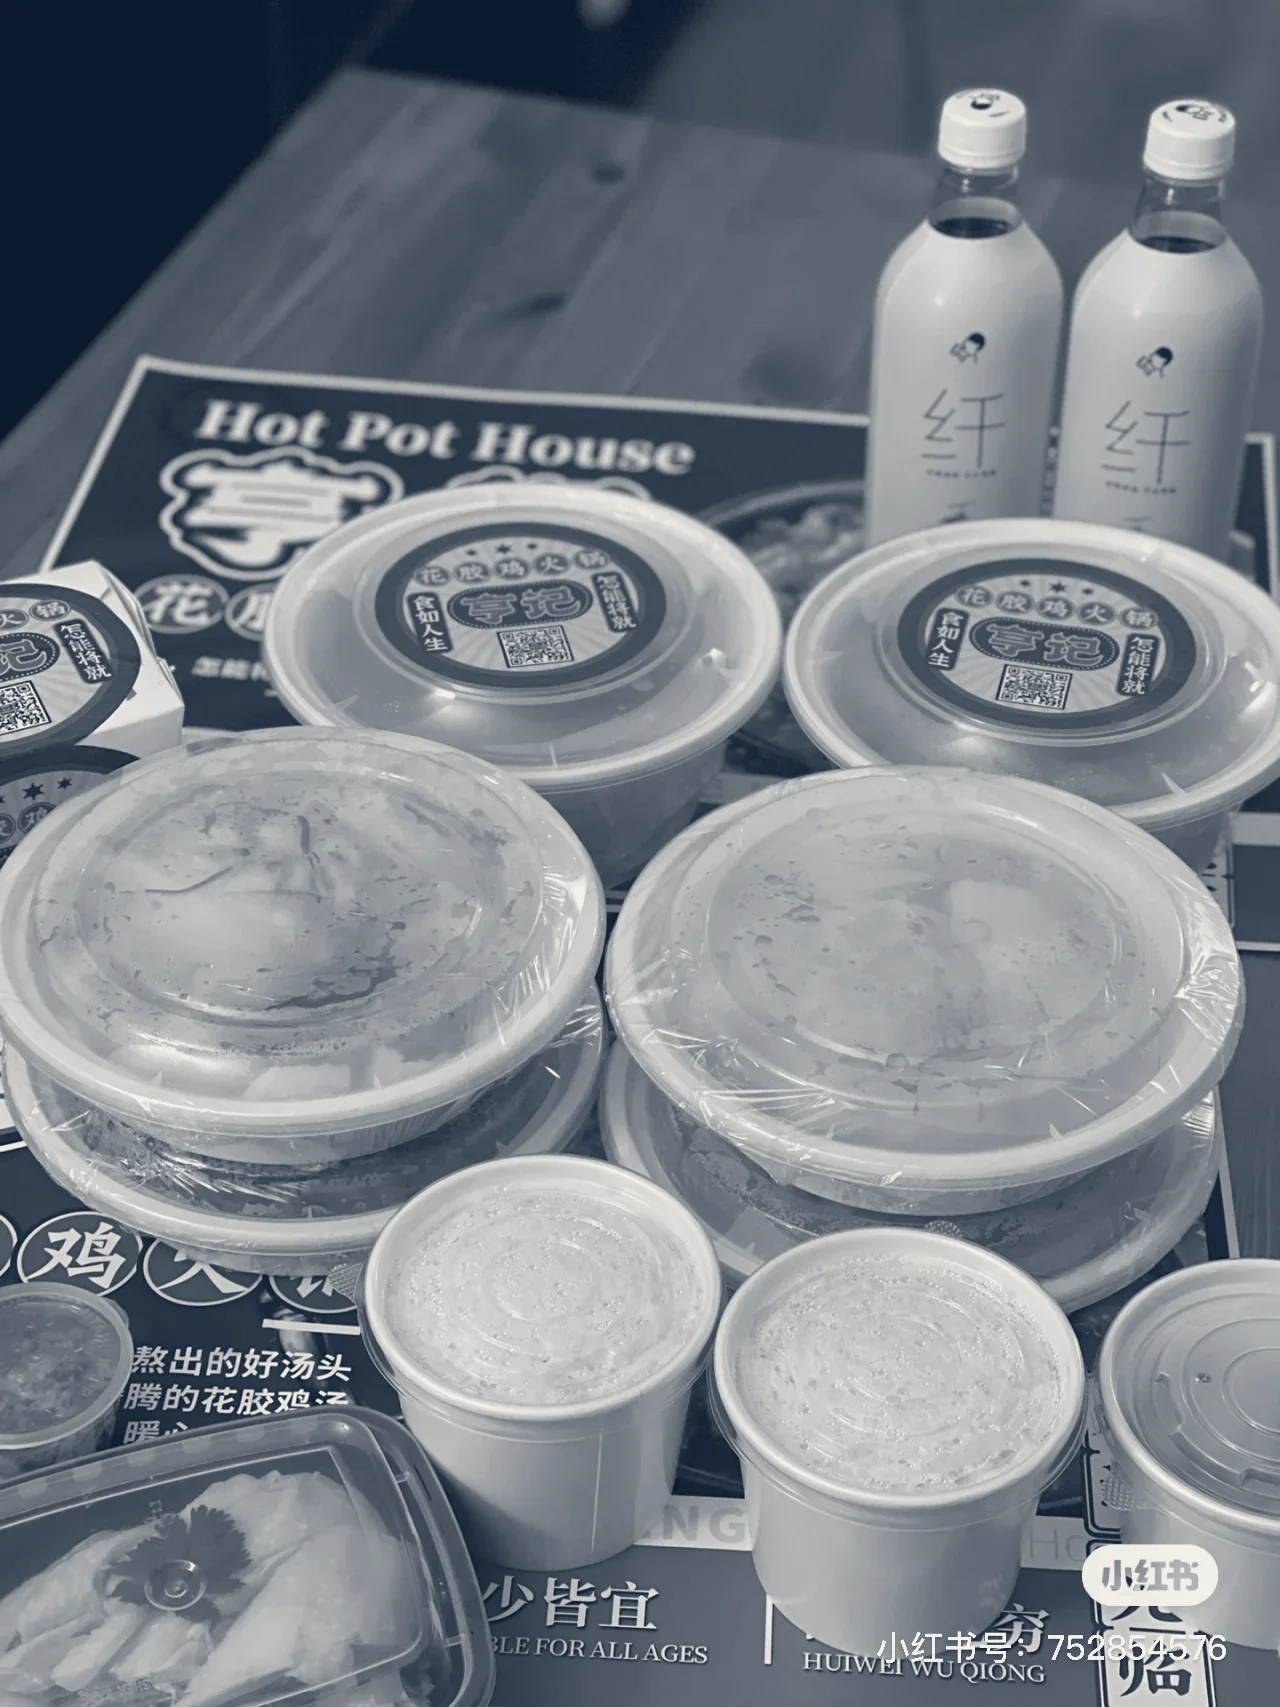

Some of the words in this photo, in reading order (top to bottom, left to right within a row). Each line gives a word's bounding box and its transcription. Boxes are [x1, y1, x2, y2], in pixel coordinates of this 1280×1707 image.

[194, 399, 330, 449] Hot
[338, 410, 461, 460] Pot
[470, 420, 696, 475] House
[419, 552, 607, 581] 花胶鸡火锅
[413, 595, 448, 652] 食如人生
[596, 574, 637, 630] 怎能将就
[962, 587, 1153, 631] 花胶鸡火锅
[60, 622, 112, 681] 怎能将就
[928, 611, 964, 668] 食如人生
[1121, 636, 1155, 696] 怎能将就
[131, 1346, 352, 1381] 熬出的好汤头
[642, 1505, 746, 1544] NG
[482, 1575, 660, 1630] 少皆宜
[534, 1638, 586, 1658] FOR
[589, 1641, 638, 1661] ALL
[641, 1643, 708, 1664] AGES
[960, 1661, 1046, 1683] QIONG
